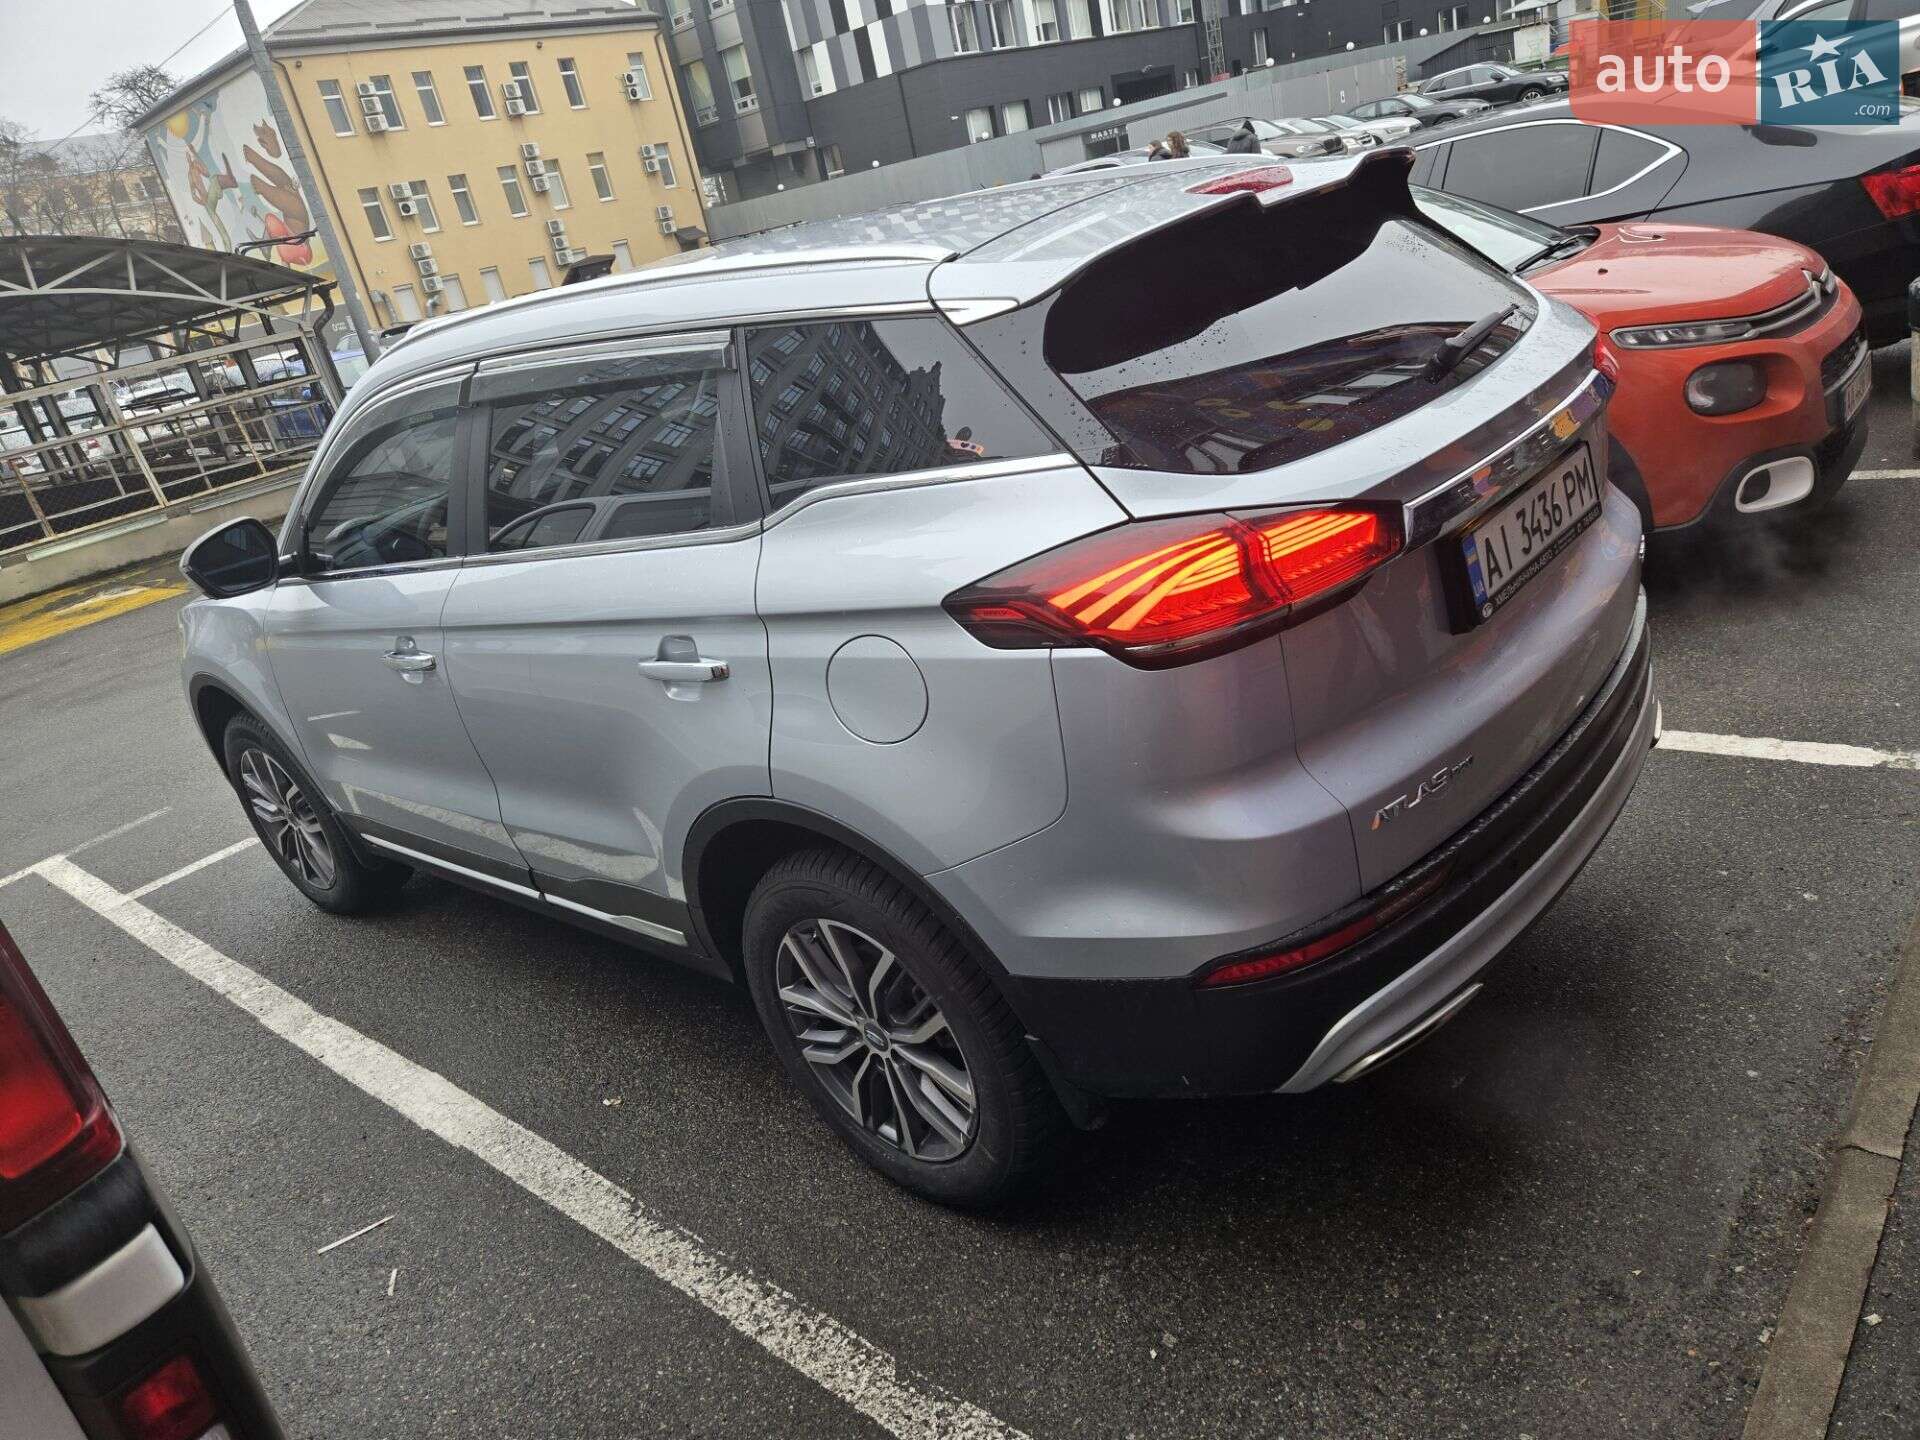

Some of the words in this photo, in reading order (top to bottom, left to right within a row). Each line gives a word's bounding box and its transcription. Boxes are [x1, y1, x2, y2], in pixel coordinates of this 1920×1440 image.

[1484, 524, 1513, 588] AI
[1515, 482, 1563, 555] 3436
[1562, 456, 1594, 517] PM
